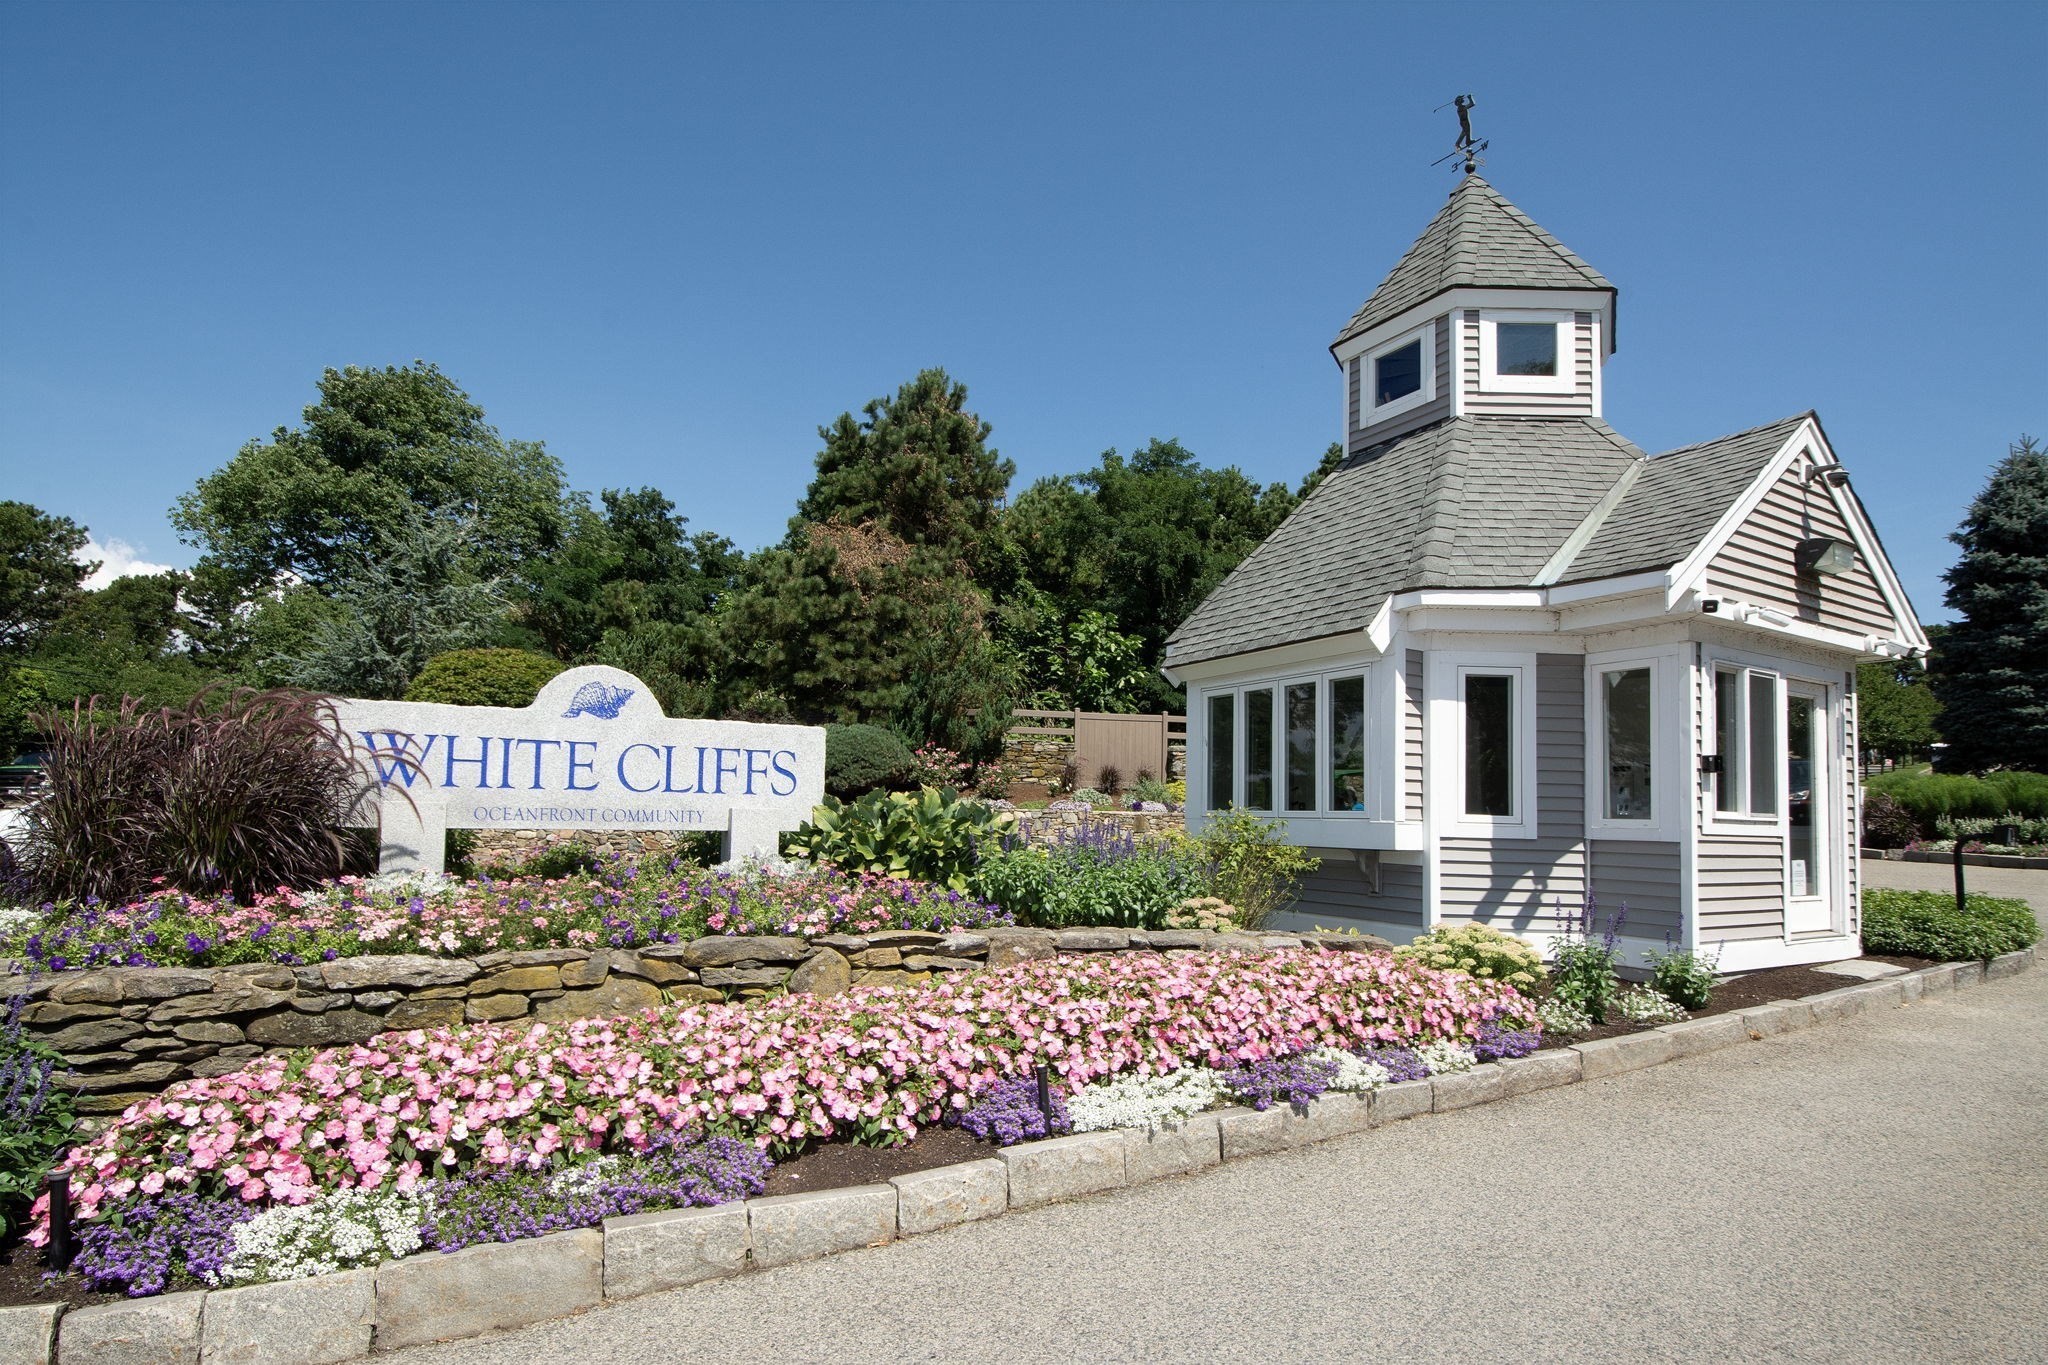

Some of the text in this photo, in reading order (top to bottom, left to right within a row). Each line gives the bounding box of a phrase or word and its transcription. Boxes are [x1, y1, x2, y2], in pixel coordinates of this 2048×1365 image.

[357, 730, 797, 796] WHITE CLIFFS
[473, 806, 705, 824] OCEANFRONT COMMUNITY
